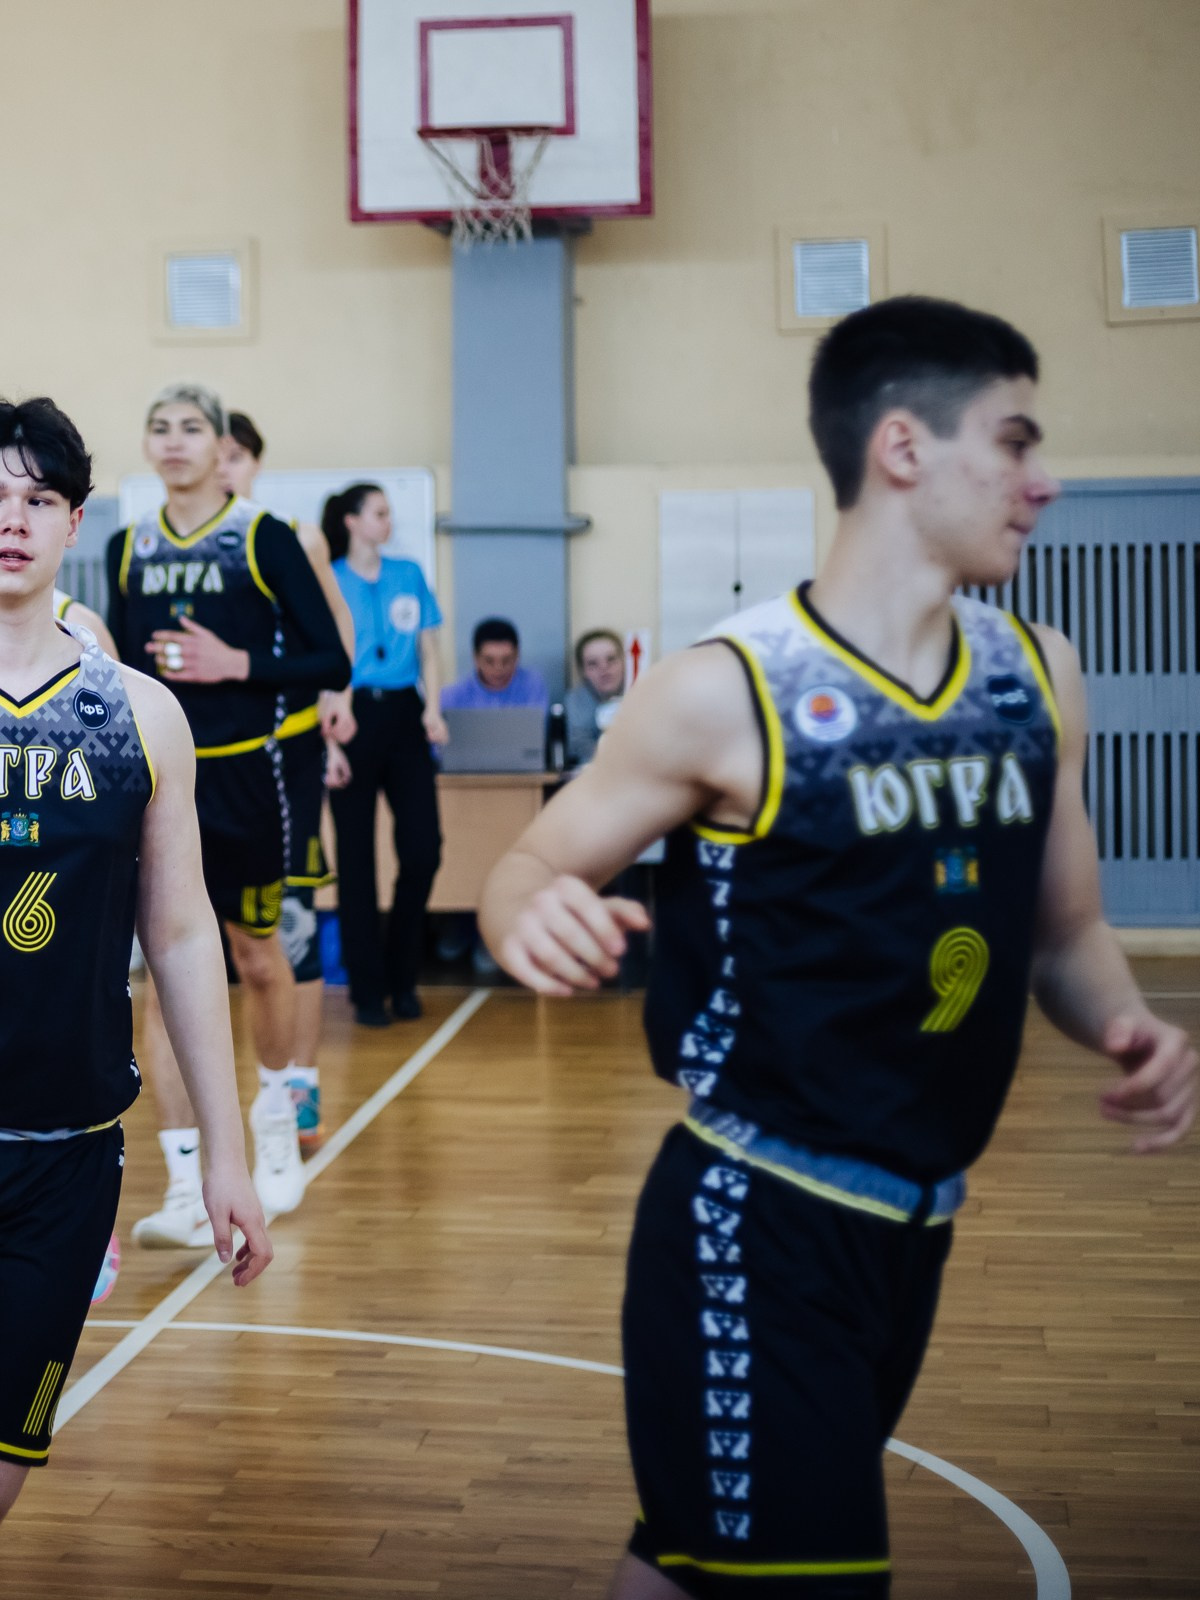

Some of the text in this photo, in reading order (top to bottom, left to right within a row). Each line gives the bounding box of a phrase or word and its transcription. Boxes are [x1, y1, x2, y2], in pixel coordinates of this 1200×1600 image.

[847, 752, 1034, 836] ЮГРА
[919, 926, 990, 1033] 9
[22, 1360, 62, 1436] 1
